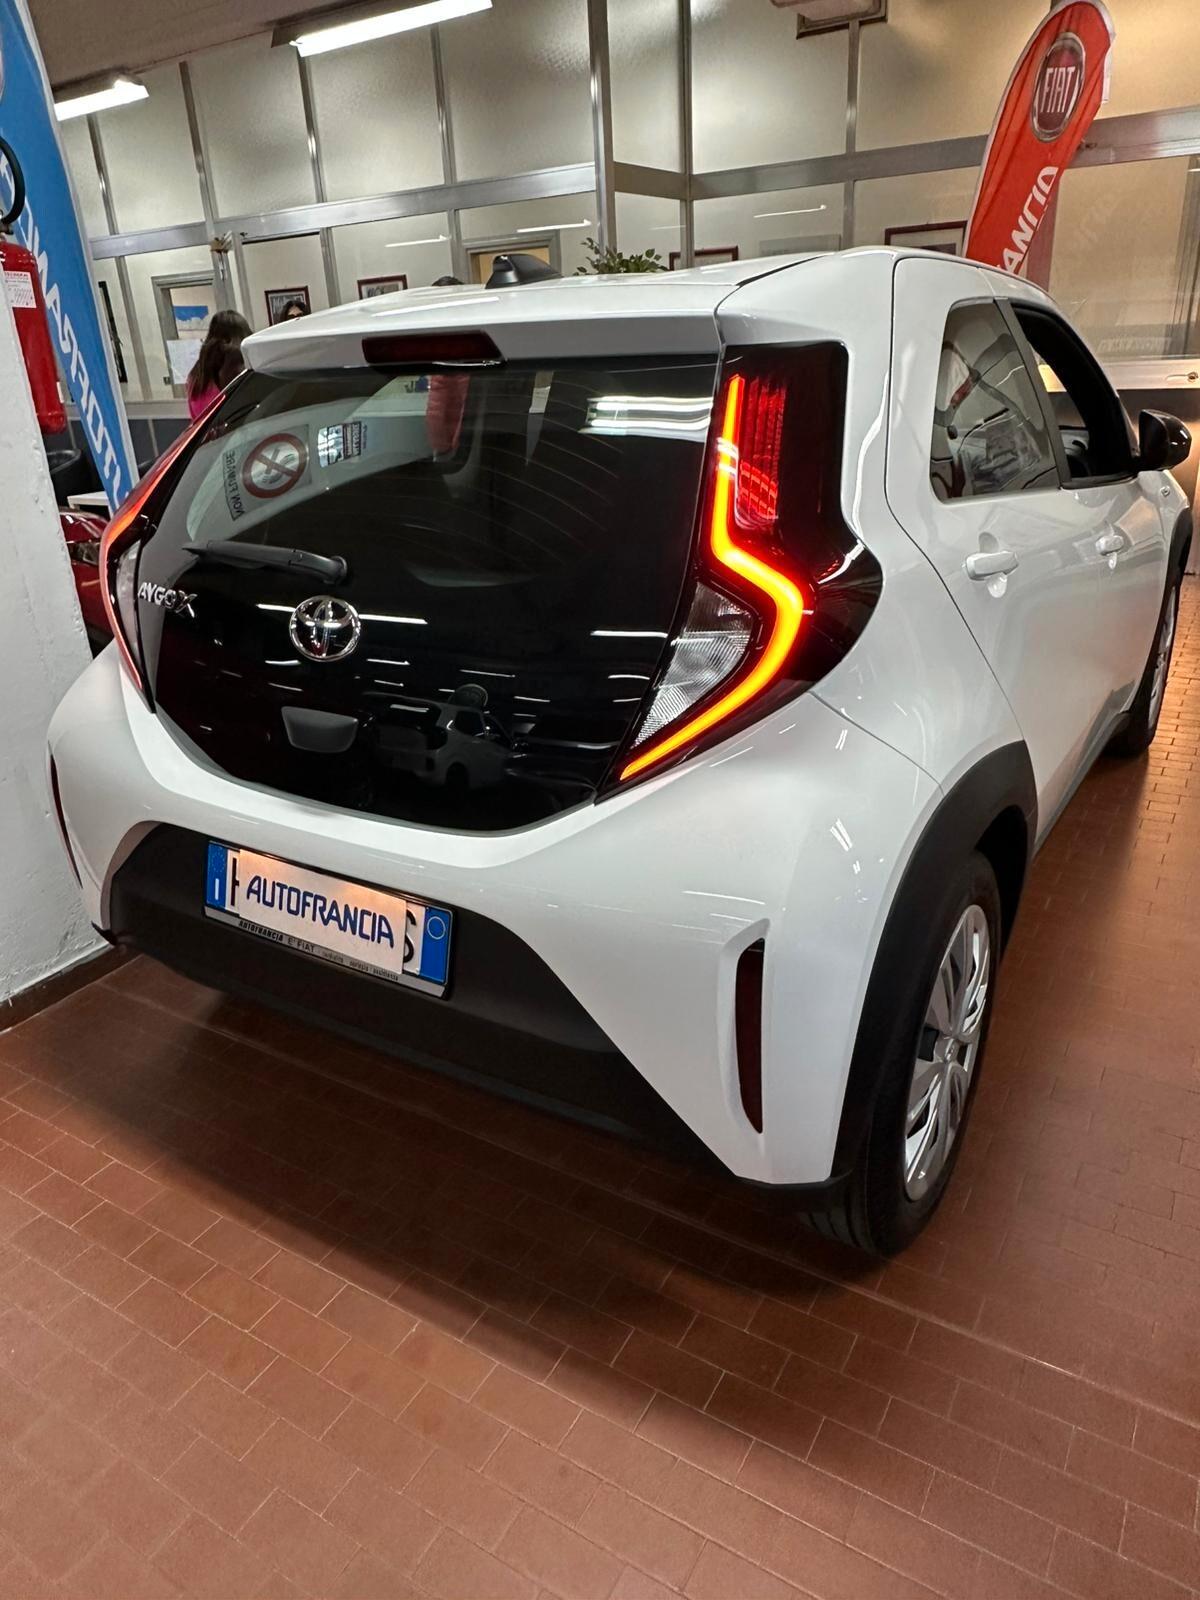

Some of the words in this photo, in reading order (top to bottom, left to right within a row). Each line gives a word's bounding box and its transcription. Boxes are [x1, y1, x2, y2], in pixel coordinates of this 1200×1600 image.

[1041, 66, 1076, 113] FIAT
[998, 165, 1059, 275] ANCIA
[246, 875, 394, 948] AUTOFRANCIA
[297, 938, 315, 953] FIAT
